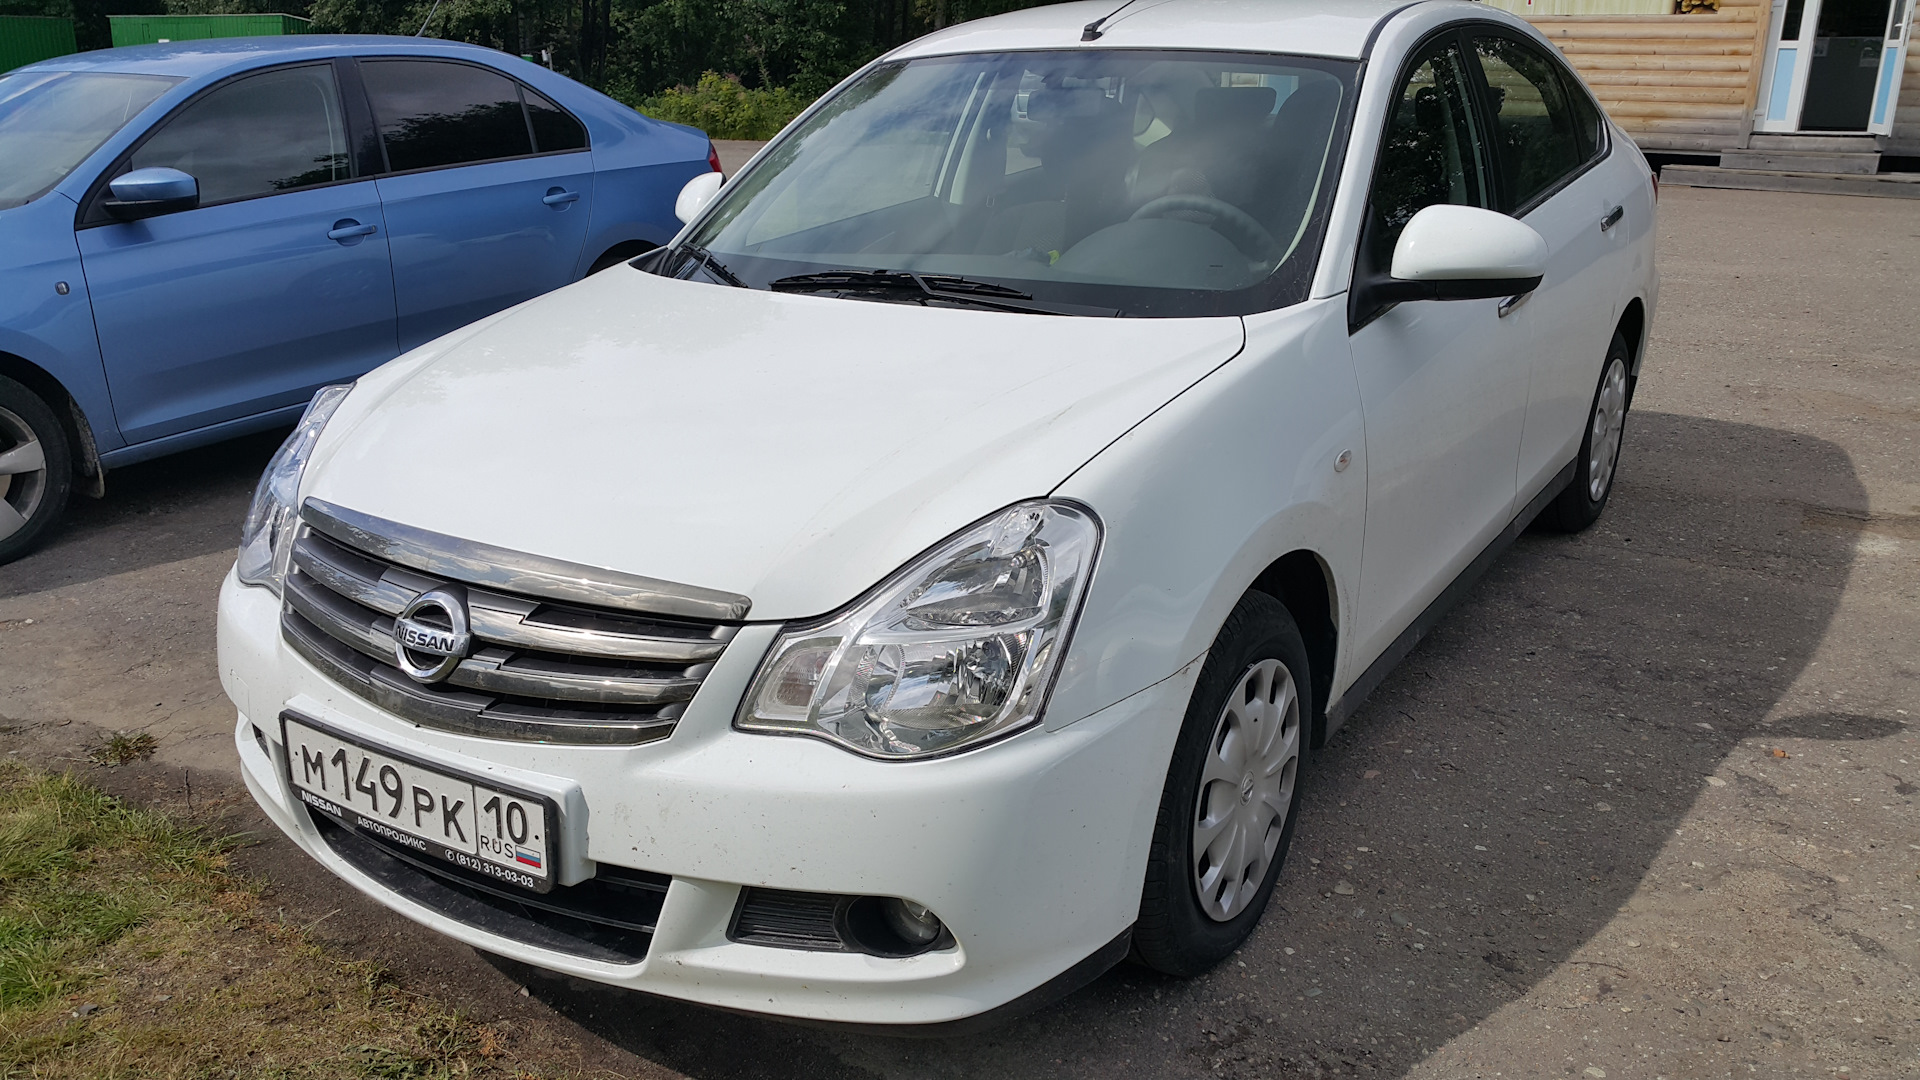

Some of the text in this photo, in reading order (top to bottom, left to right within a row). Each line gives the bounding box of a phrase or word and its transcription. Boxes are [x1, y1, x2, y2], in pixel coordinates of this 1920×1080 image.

[396, 624, 455, 652] NISSAN
[301, 790, 342, 818] NISSAN
[357, 816, 427, 851] АВТОПРОДИКС
[483, 795, 528, 845] 10
[480, 834, 515, 859] RUS
[456, 852, 534, 888] (812) 313-03-03
